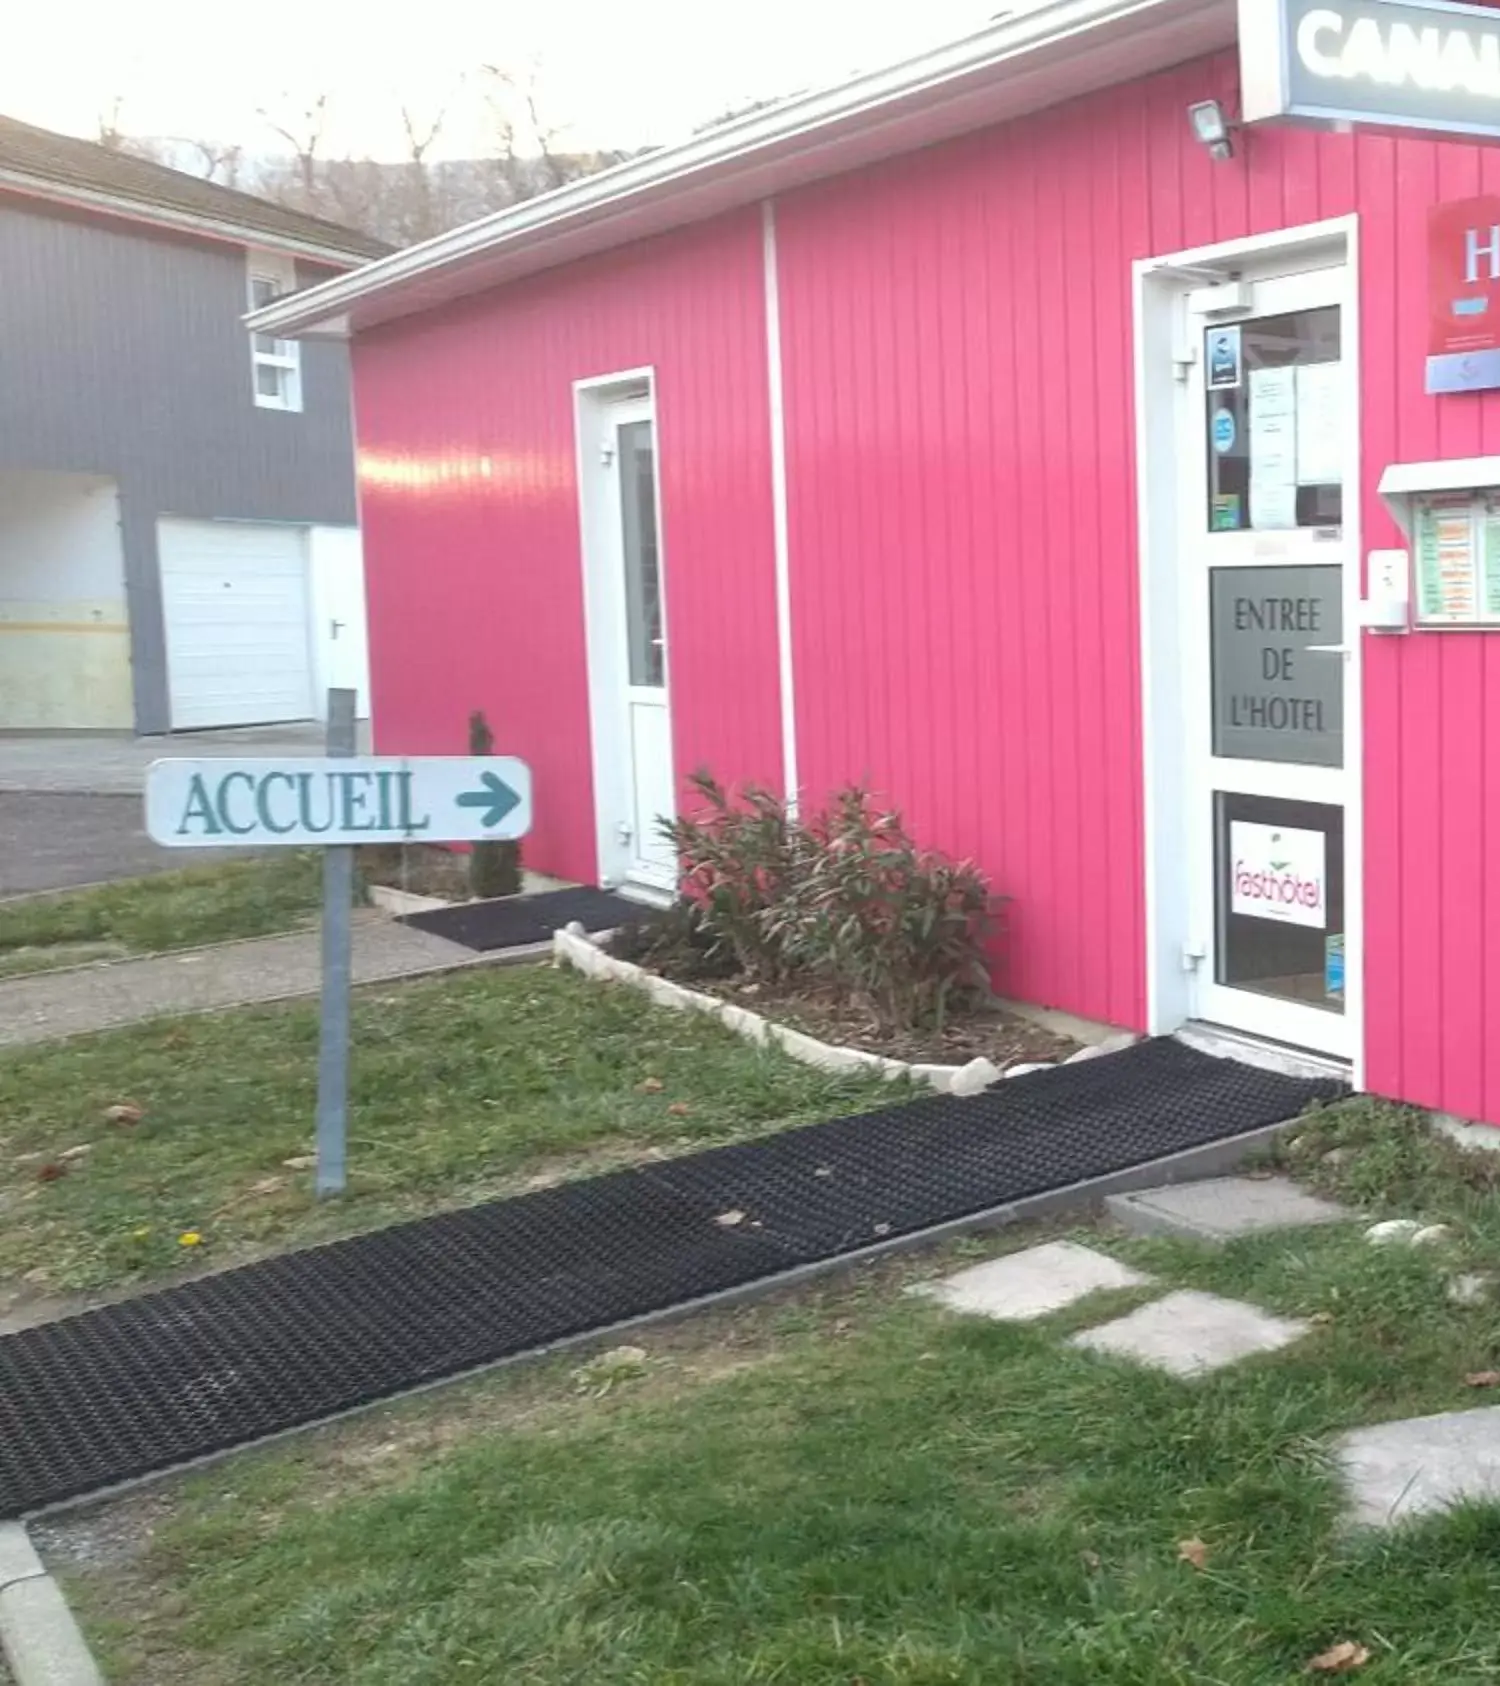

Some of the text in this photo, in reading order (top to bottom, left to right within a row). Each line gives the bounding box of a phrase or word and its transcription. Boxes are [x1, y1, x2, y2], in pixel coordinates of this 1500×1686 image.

[1234, 597, 1323, 631] ENTREE
[1263, 647, 1294, 681] DE
[1231, 695, 1326, 732] L'HOTEL
[176, 771, 431, 836] ACCUEIL
